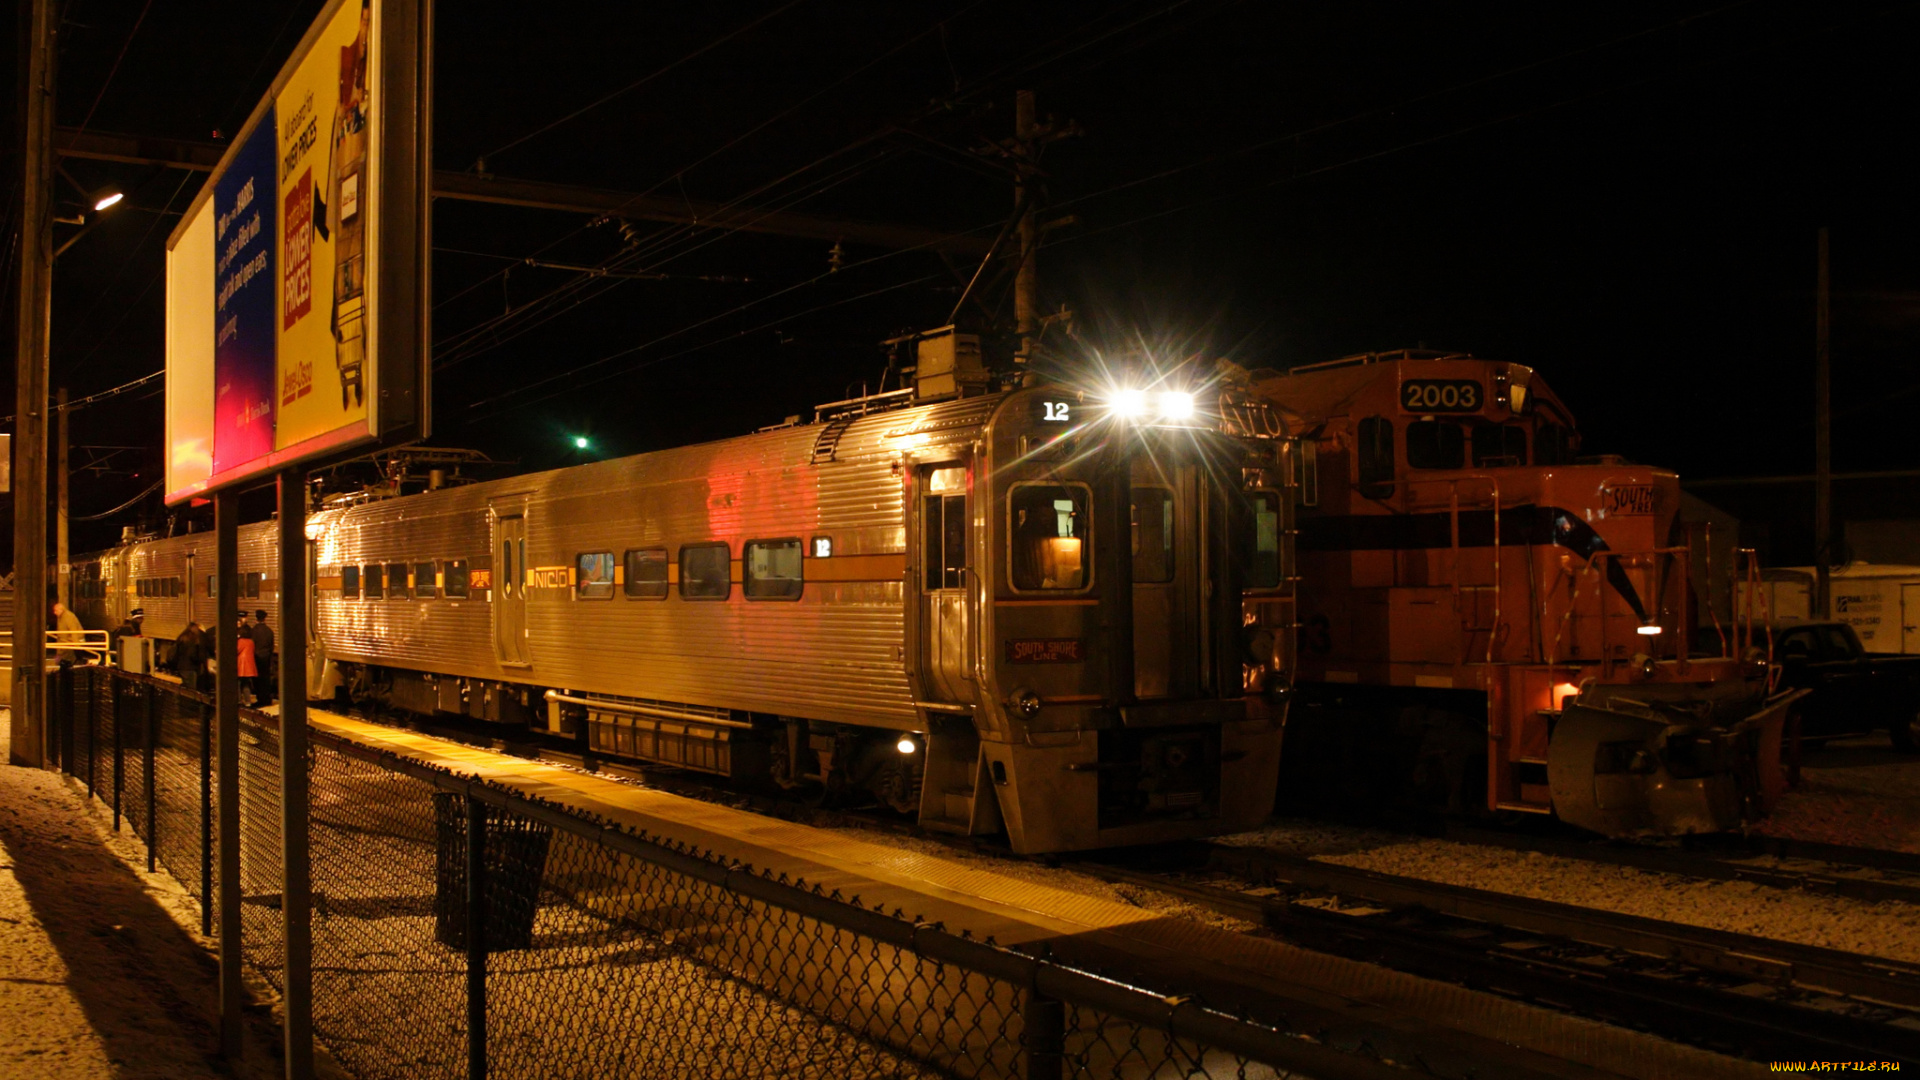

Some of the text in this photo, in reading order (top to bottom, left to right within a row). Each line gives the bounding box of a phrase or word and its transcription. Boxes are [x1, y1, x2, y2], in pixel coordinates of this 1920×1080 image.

[282, 115, 317, 184] LOWER PRICES
[285, 220, 310, 276] LOWER
[285, 259, 310, 317] PRICES
[1407, 384, 1477, 408] 2003
[1043, 401, 1070, 422] 12
[1613, 488, 1654, 512] SOUTH
[1014, 640, 1078, 660] SOUTH SHORE
[1033, 652, 1058, 661] LINE
